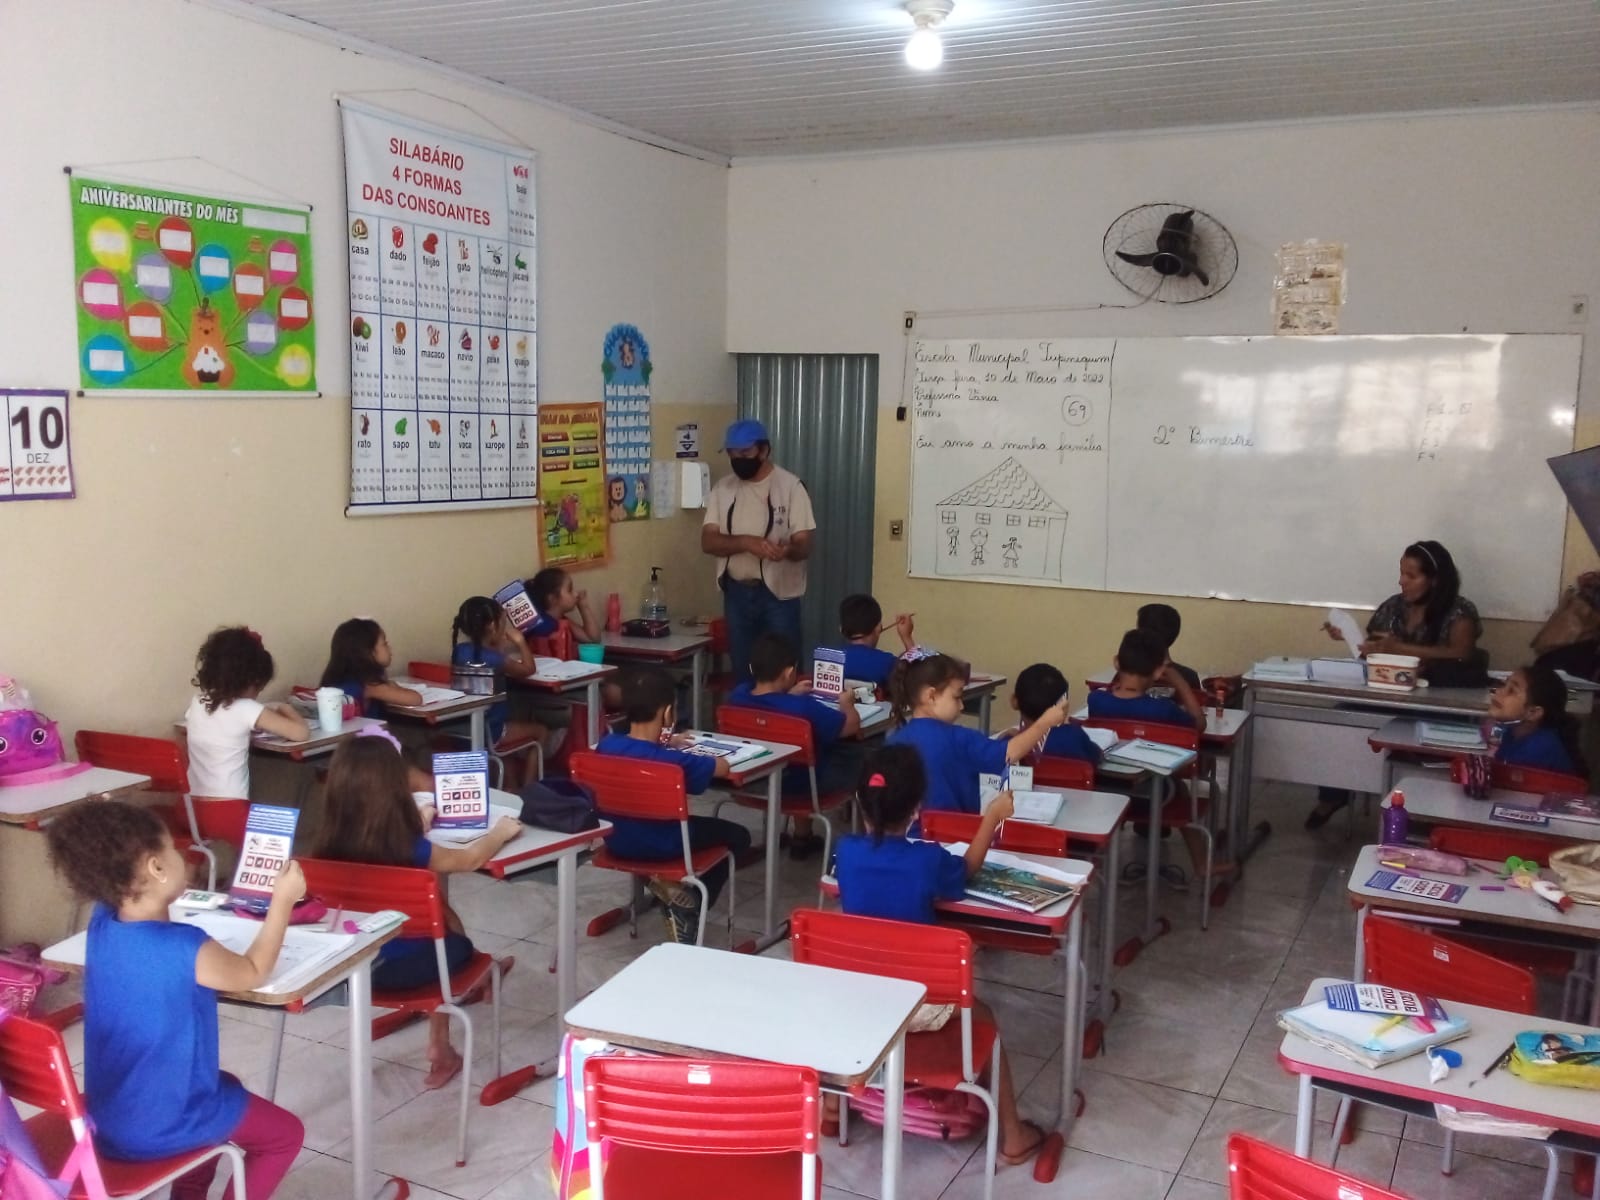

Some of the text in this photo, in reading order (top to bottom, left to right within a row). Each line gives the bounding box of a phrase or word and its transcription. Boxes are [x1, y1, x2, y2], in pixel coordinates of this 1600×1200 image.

[389, 137, 464, 171] SILABÁRIO
[392, 165, 462, 196] 4 FORMAS
[80, 186, 239, 224] ANIVERSARIANTES DO MÊS
[362, 183, 394, 206] DAS
[397, 192, 491, 226] CONSOANTES
[351, 245, 369, 256] casa
[389, 250, 407, 262] dado
[456, 262, 471, 274] gato
[354, 342, 369, 353] kiwi
[420, 349, 445, 360] macaco
[457, 352, 474, 363] navio
[914, 343, 956, 363] Escola
[968, 342, 1029, 371] Municipal
[11, 405, 64, 450] 10
[1189, 425, 1255, 447] Bimestre
[357, 440, 371, 449] rato
[392, 440, 410, 452] sapo
[428, 440, 441, 449] tatu
[458, 441, 472, 450] vaca
[485, 441, 505, 452] xarope
[26, 452, 51, 464] DEZ
